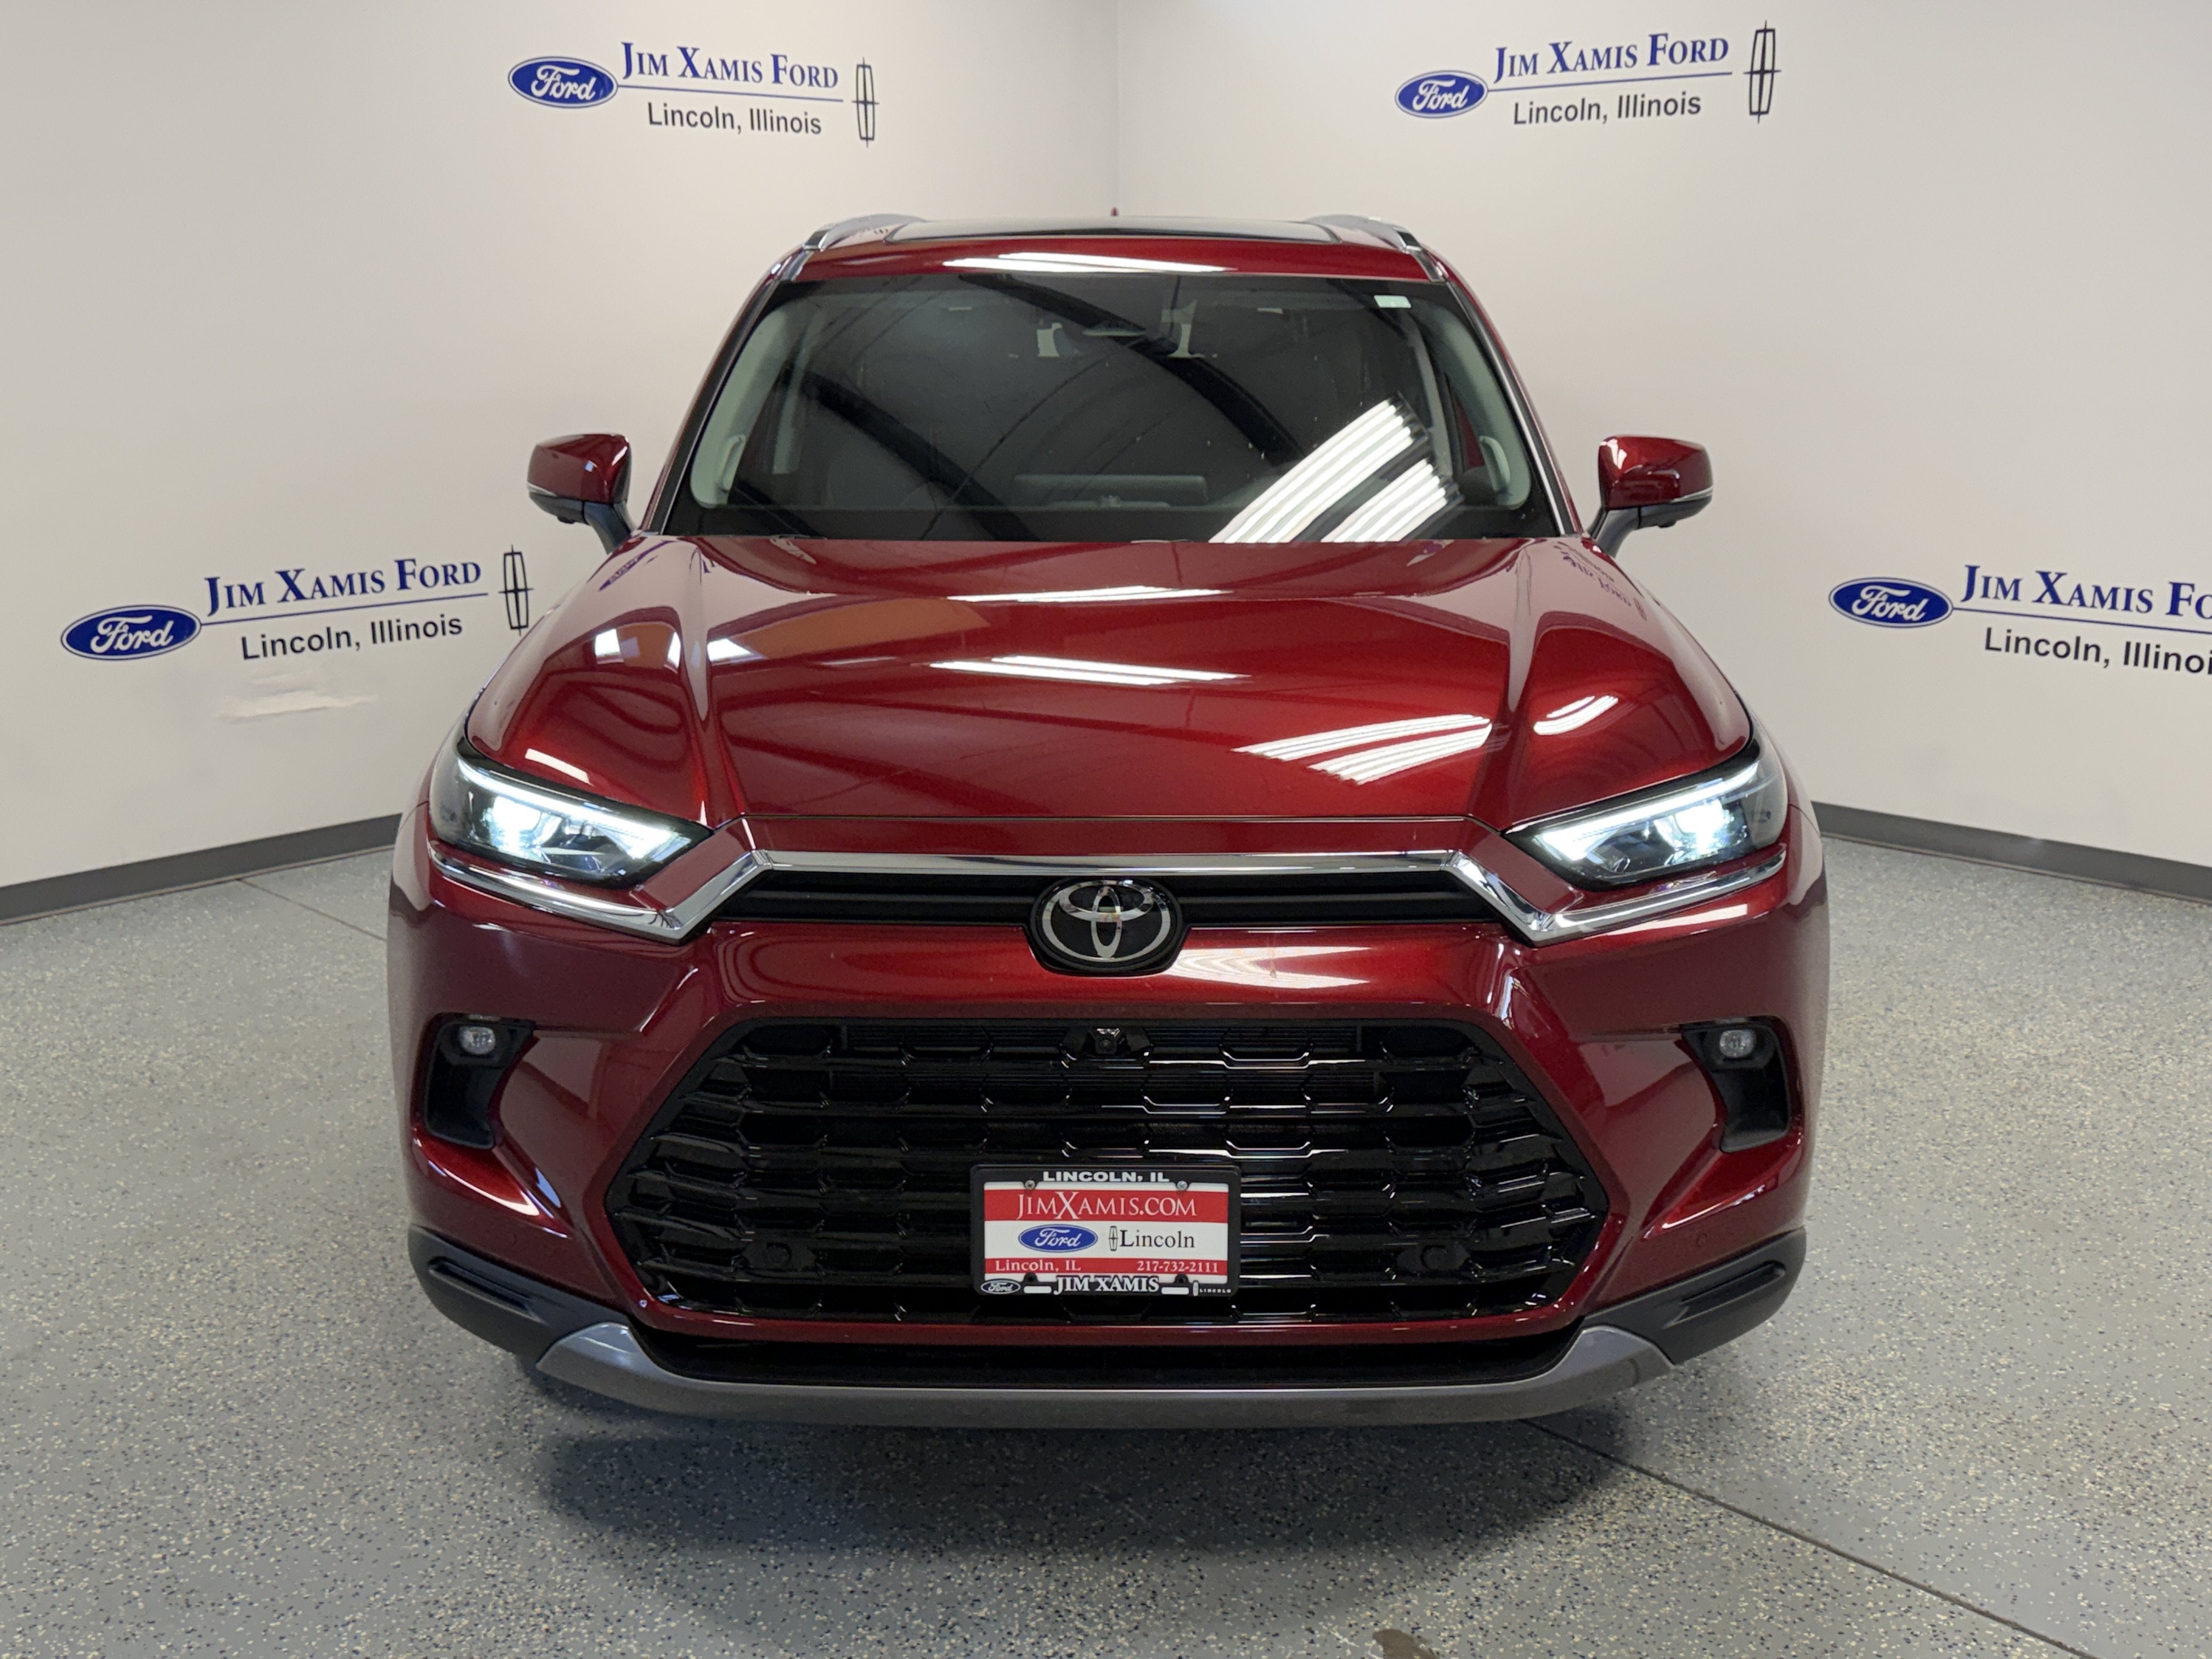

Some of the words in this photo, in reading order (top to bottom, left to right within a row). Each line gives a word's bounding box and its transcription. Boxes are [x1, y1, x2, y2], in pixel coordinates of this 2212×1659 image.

[620, 41, 670, 80] JIM
[676, 46, 763, 84] XAMIS
[770, 53, 839, 89] FORD
[1493, 47, 1539, 84] JIM
[1546, 41, 1638, 74] XAMIS
[1646, 32, 1729, 66] FORD
[531, 65, 597, 100] Ford
[1412, 78, 1470, 111] Ford
[647, 101, 742, 135] Lincoln,
[749, 108, 822, 136] Illinois
[1514, 98, 1608, 125] Lincoln,
[1617, 91, 1701, 120] Illinois
[204, 576, 267, 617] JIM
[274, 568, 386, 603] XAMIS
[393, 558, 482, 591] FORD
[1852, 585, 1929, 622] Ford
[1960, 564, 2023, 603] JIM
[2031, 570, 2153, 614] XAMIS
[90, 614, 174, 654] Ford
[241, 626, 360, 661] Lincoln,
[370, 613, 464, 645] Illinois
[1984, 627, 2111, 669] Lincoln,
[1043, 1171, 1143, 1182] LINCOLN,
[1150, 1172, 1170, 1182] IL
[1016, 1191, 1197, 1220] JIMXAMIS.COM
[1034, 1228, 1081, 1247] Ford
[1120, 1230, 1195, 1248] Lincoln
[995, 1260, 1059, 1272] Lincoln,
[1065, 1260, 1081, 1271] IL
[1137, 1261, 1218, 1273] 217-732-2111
[988, 1282, 1014, 1292] Ford
[1053, 1277, 1090, 1295] JIM
[1095, 1277, 1160, 1292] XAMIS
